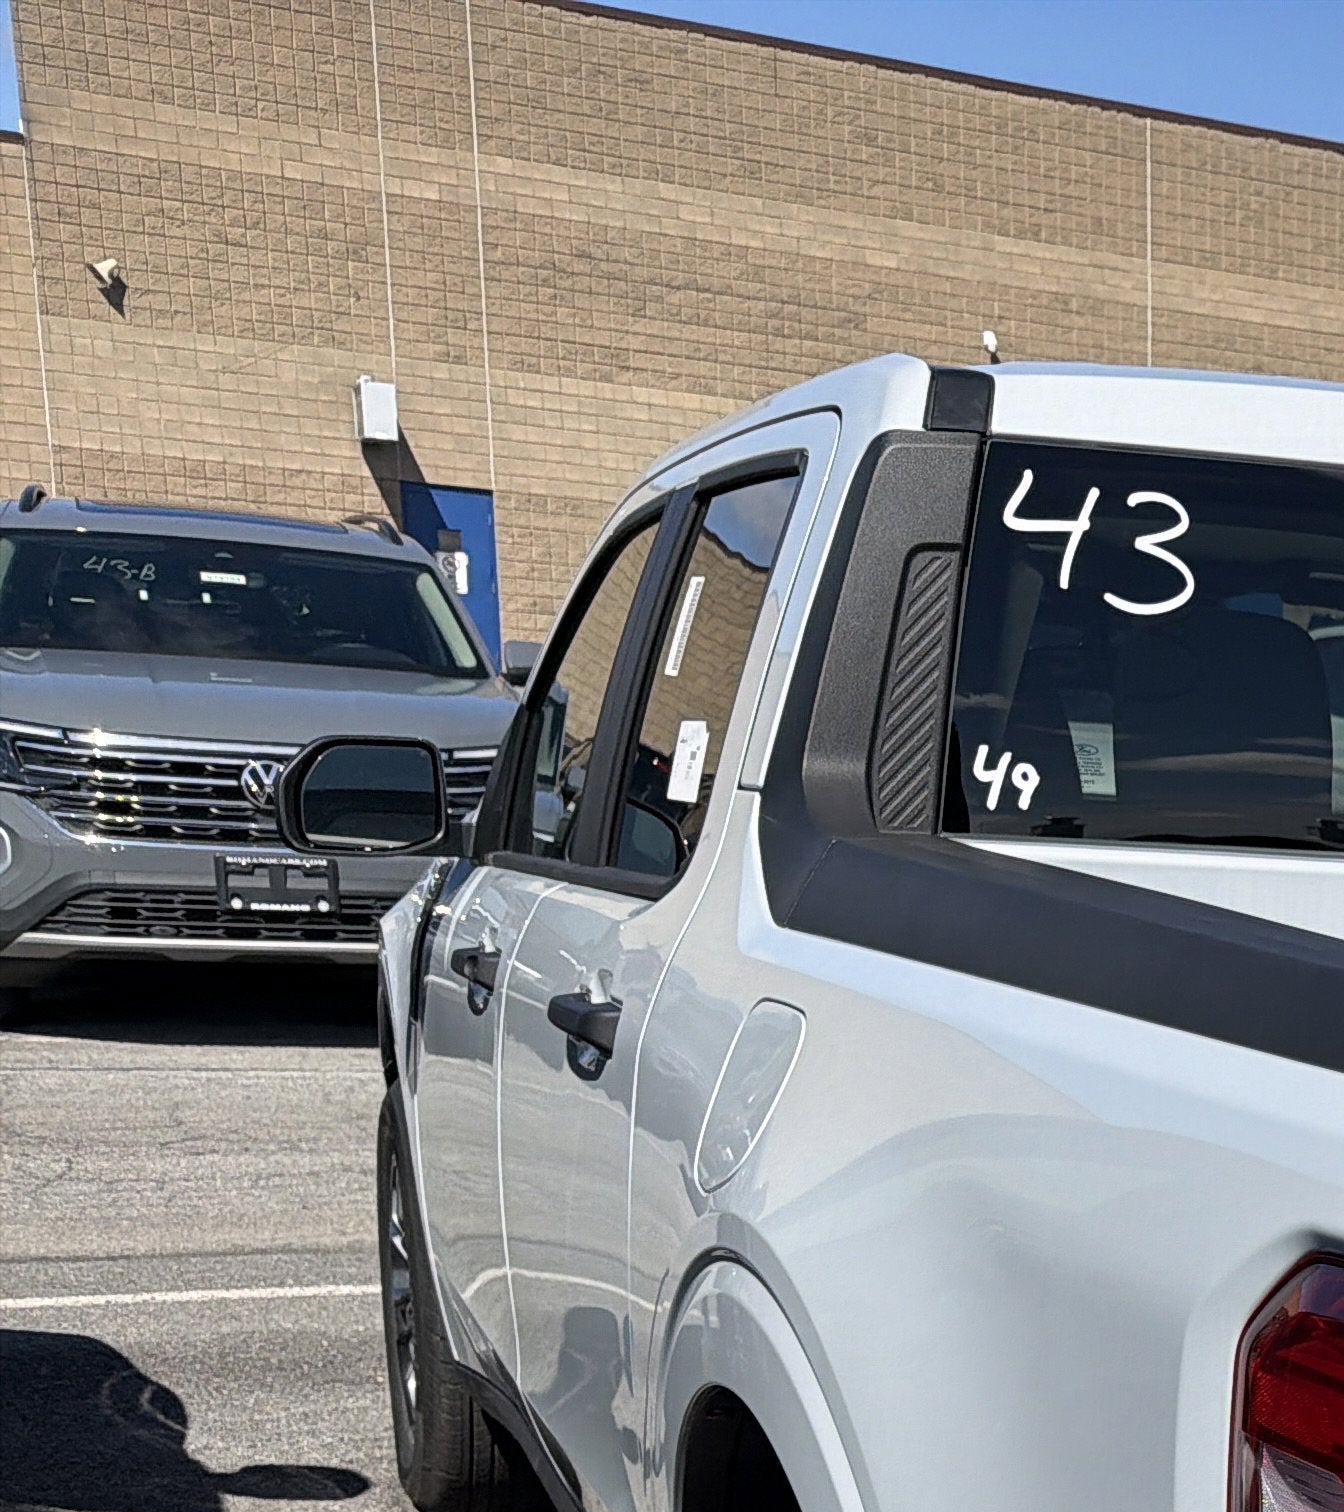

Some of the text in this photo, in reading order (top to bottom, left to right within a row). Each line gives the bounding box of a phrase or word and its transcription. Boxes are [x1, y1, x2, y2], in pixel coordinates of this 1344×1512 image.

[83, 556, 156, 581] 43-B
[1003, 469, 1195, 615] 43
[973, 744, 1040, 811] 49
